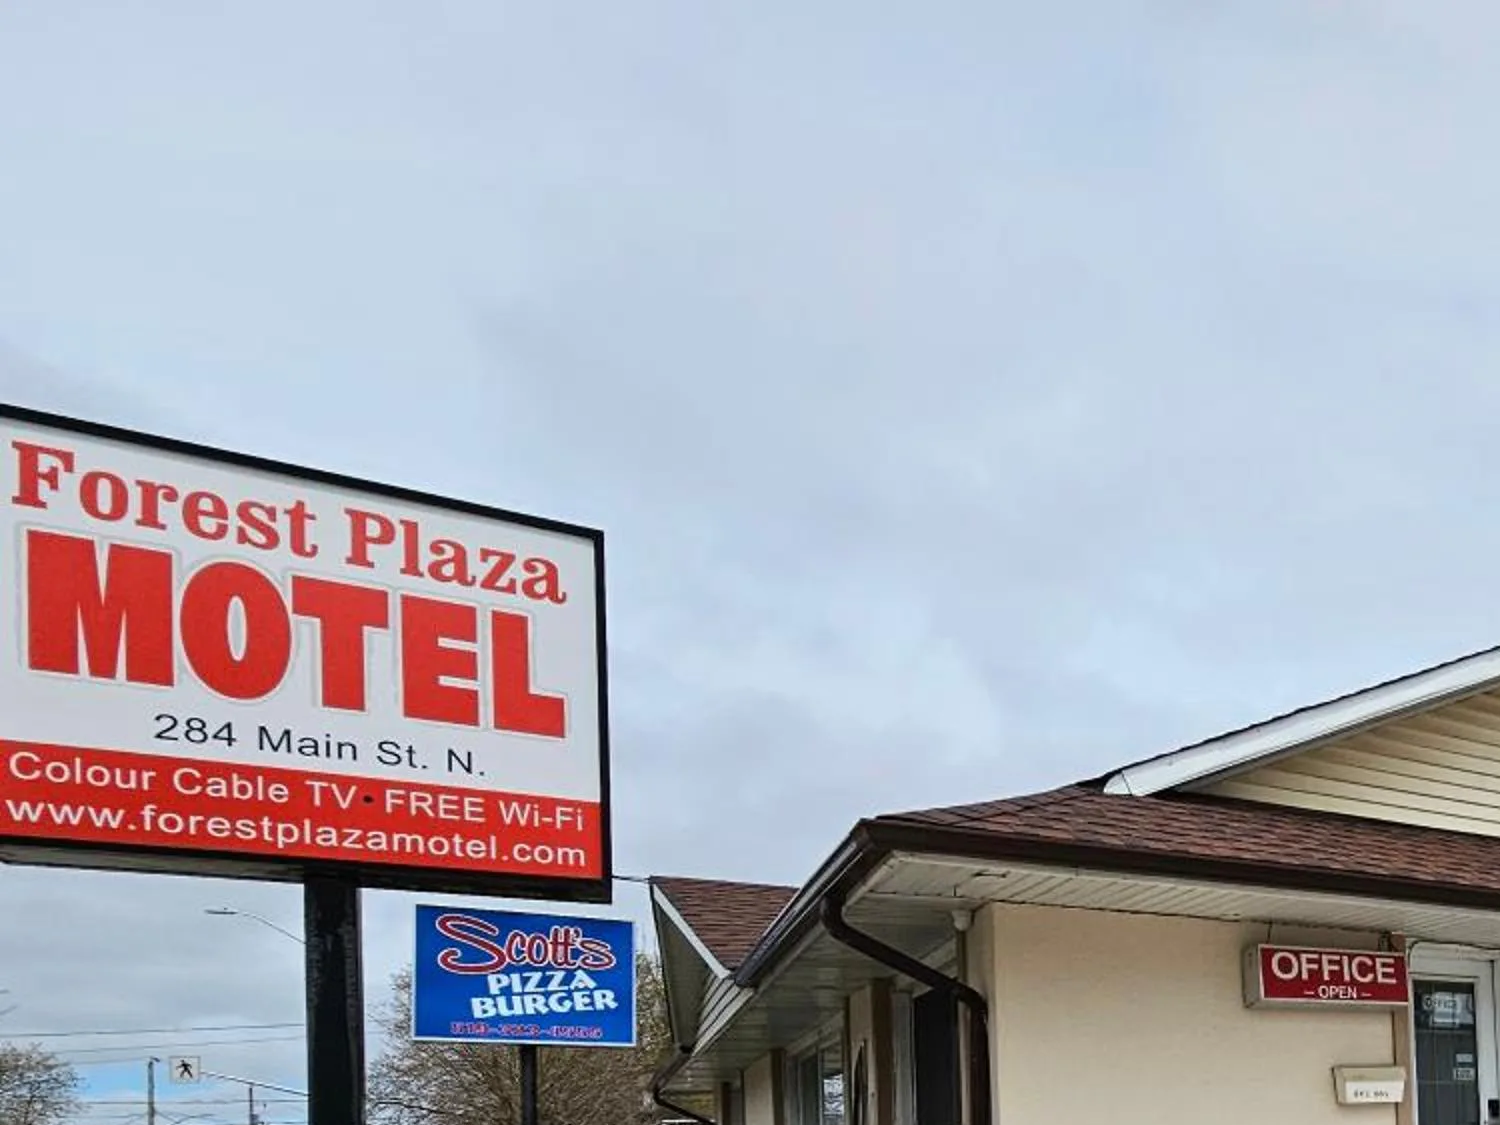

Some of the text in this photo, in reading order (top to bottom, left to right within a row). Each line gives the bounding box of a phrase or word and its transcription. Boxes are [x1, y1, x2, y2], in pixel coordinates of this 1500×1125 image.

[11, 440, 567, 604] Forest Plaza
[26, 529, 566, 738] MOTEL
[153, 713, 487, 776] 284 Main St. N.
[9, 752, 156, 791] Colour
[172, 766, 289, 804] Cable
[499, 800, 584, 832] Wi-Fi
[7, 799, 587, 867] www.forestplazamotel.com
[436, 914, 616, 974] Scott's
[1271, 951, 1397, 985] OFFICE
[470, 989, 618, 1019] BURGER
[487, 970, 597, 994] PIZZA
[1318, 985, 1358, 1000] OPEN
